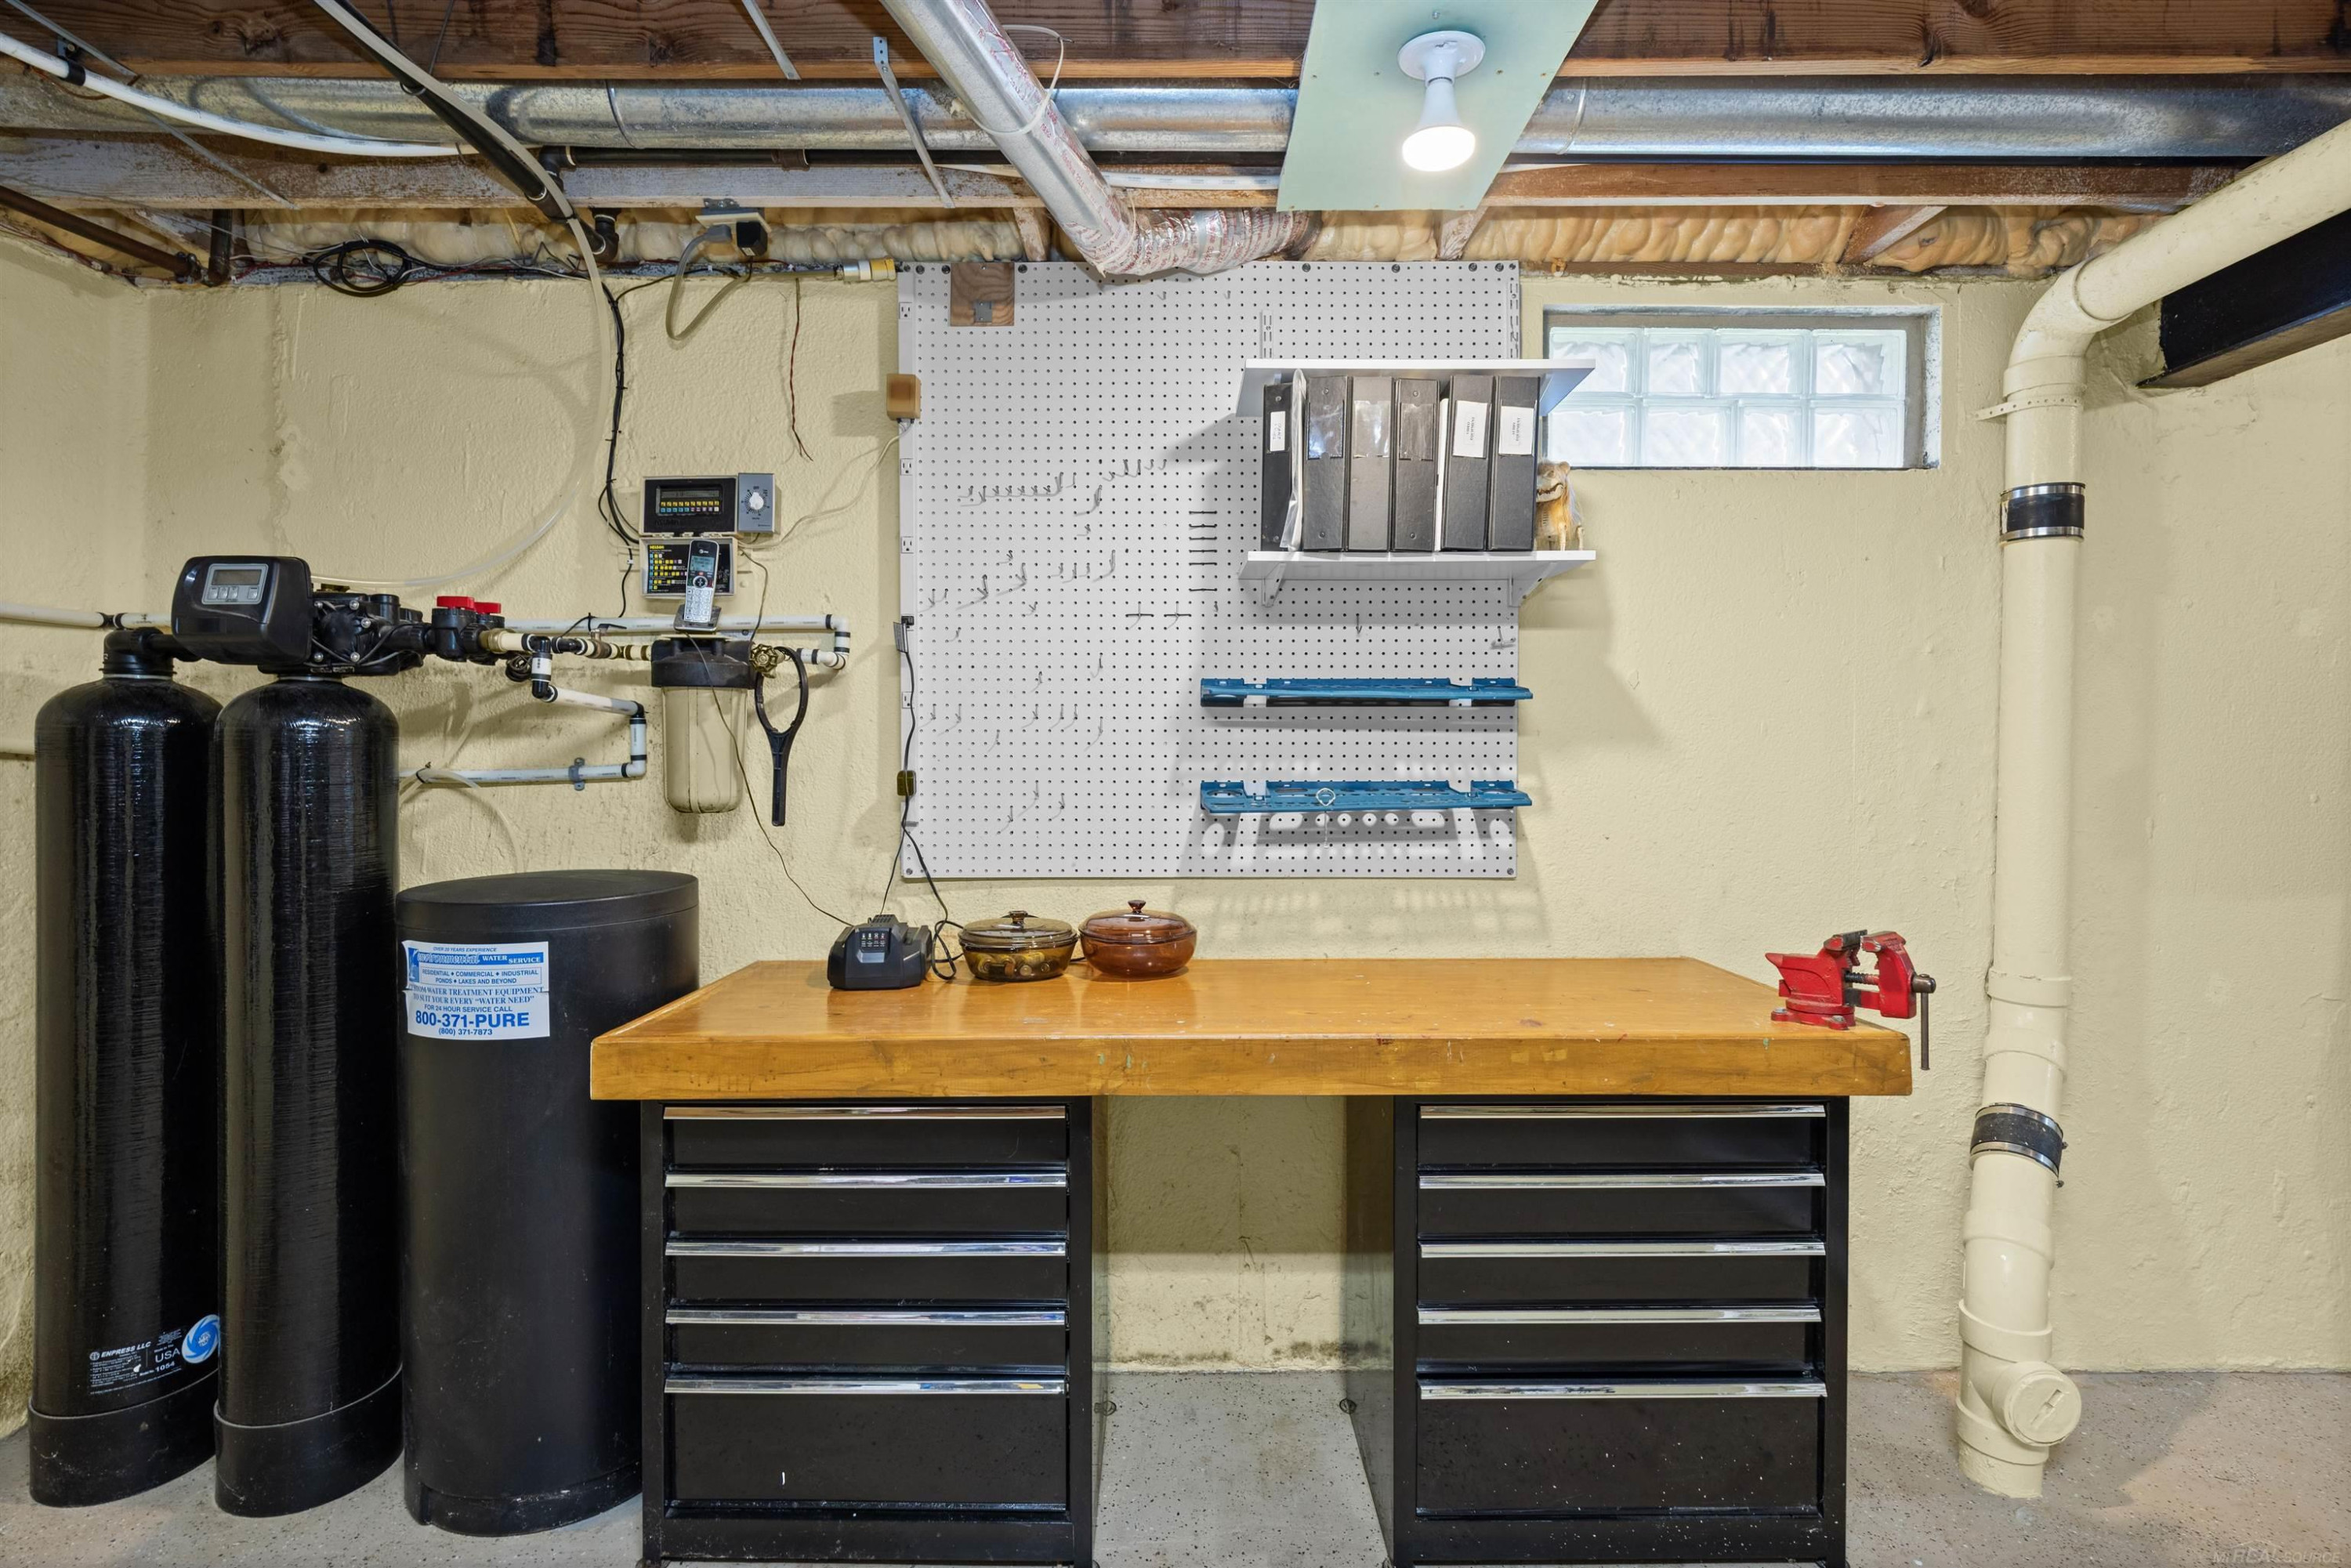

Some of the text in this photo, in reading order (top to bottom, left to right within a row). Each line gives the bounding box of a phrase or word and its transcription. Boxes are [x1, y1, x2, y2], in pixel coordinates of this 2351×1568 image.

[495, 987, 544, 996] EQUIPMENT
[415, 1010, 529, 1028] 800-371-PURE
[101, 1342, 151, 1358] ENPRESS LLC
[155, 1348, 180, 1363] USA
